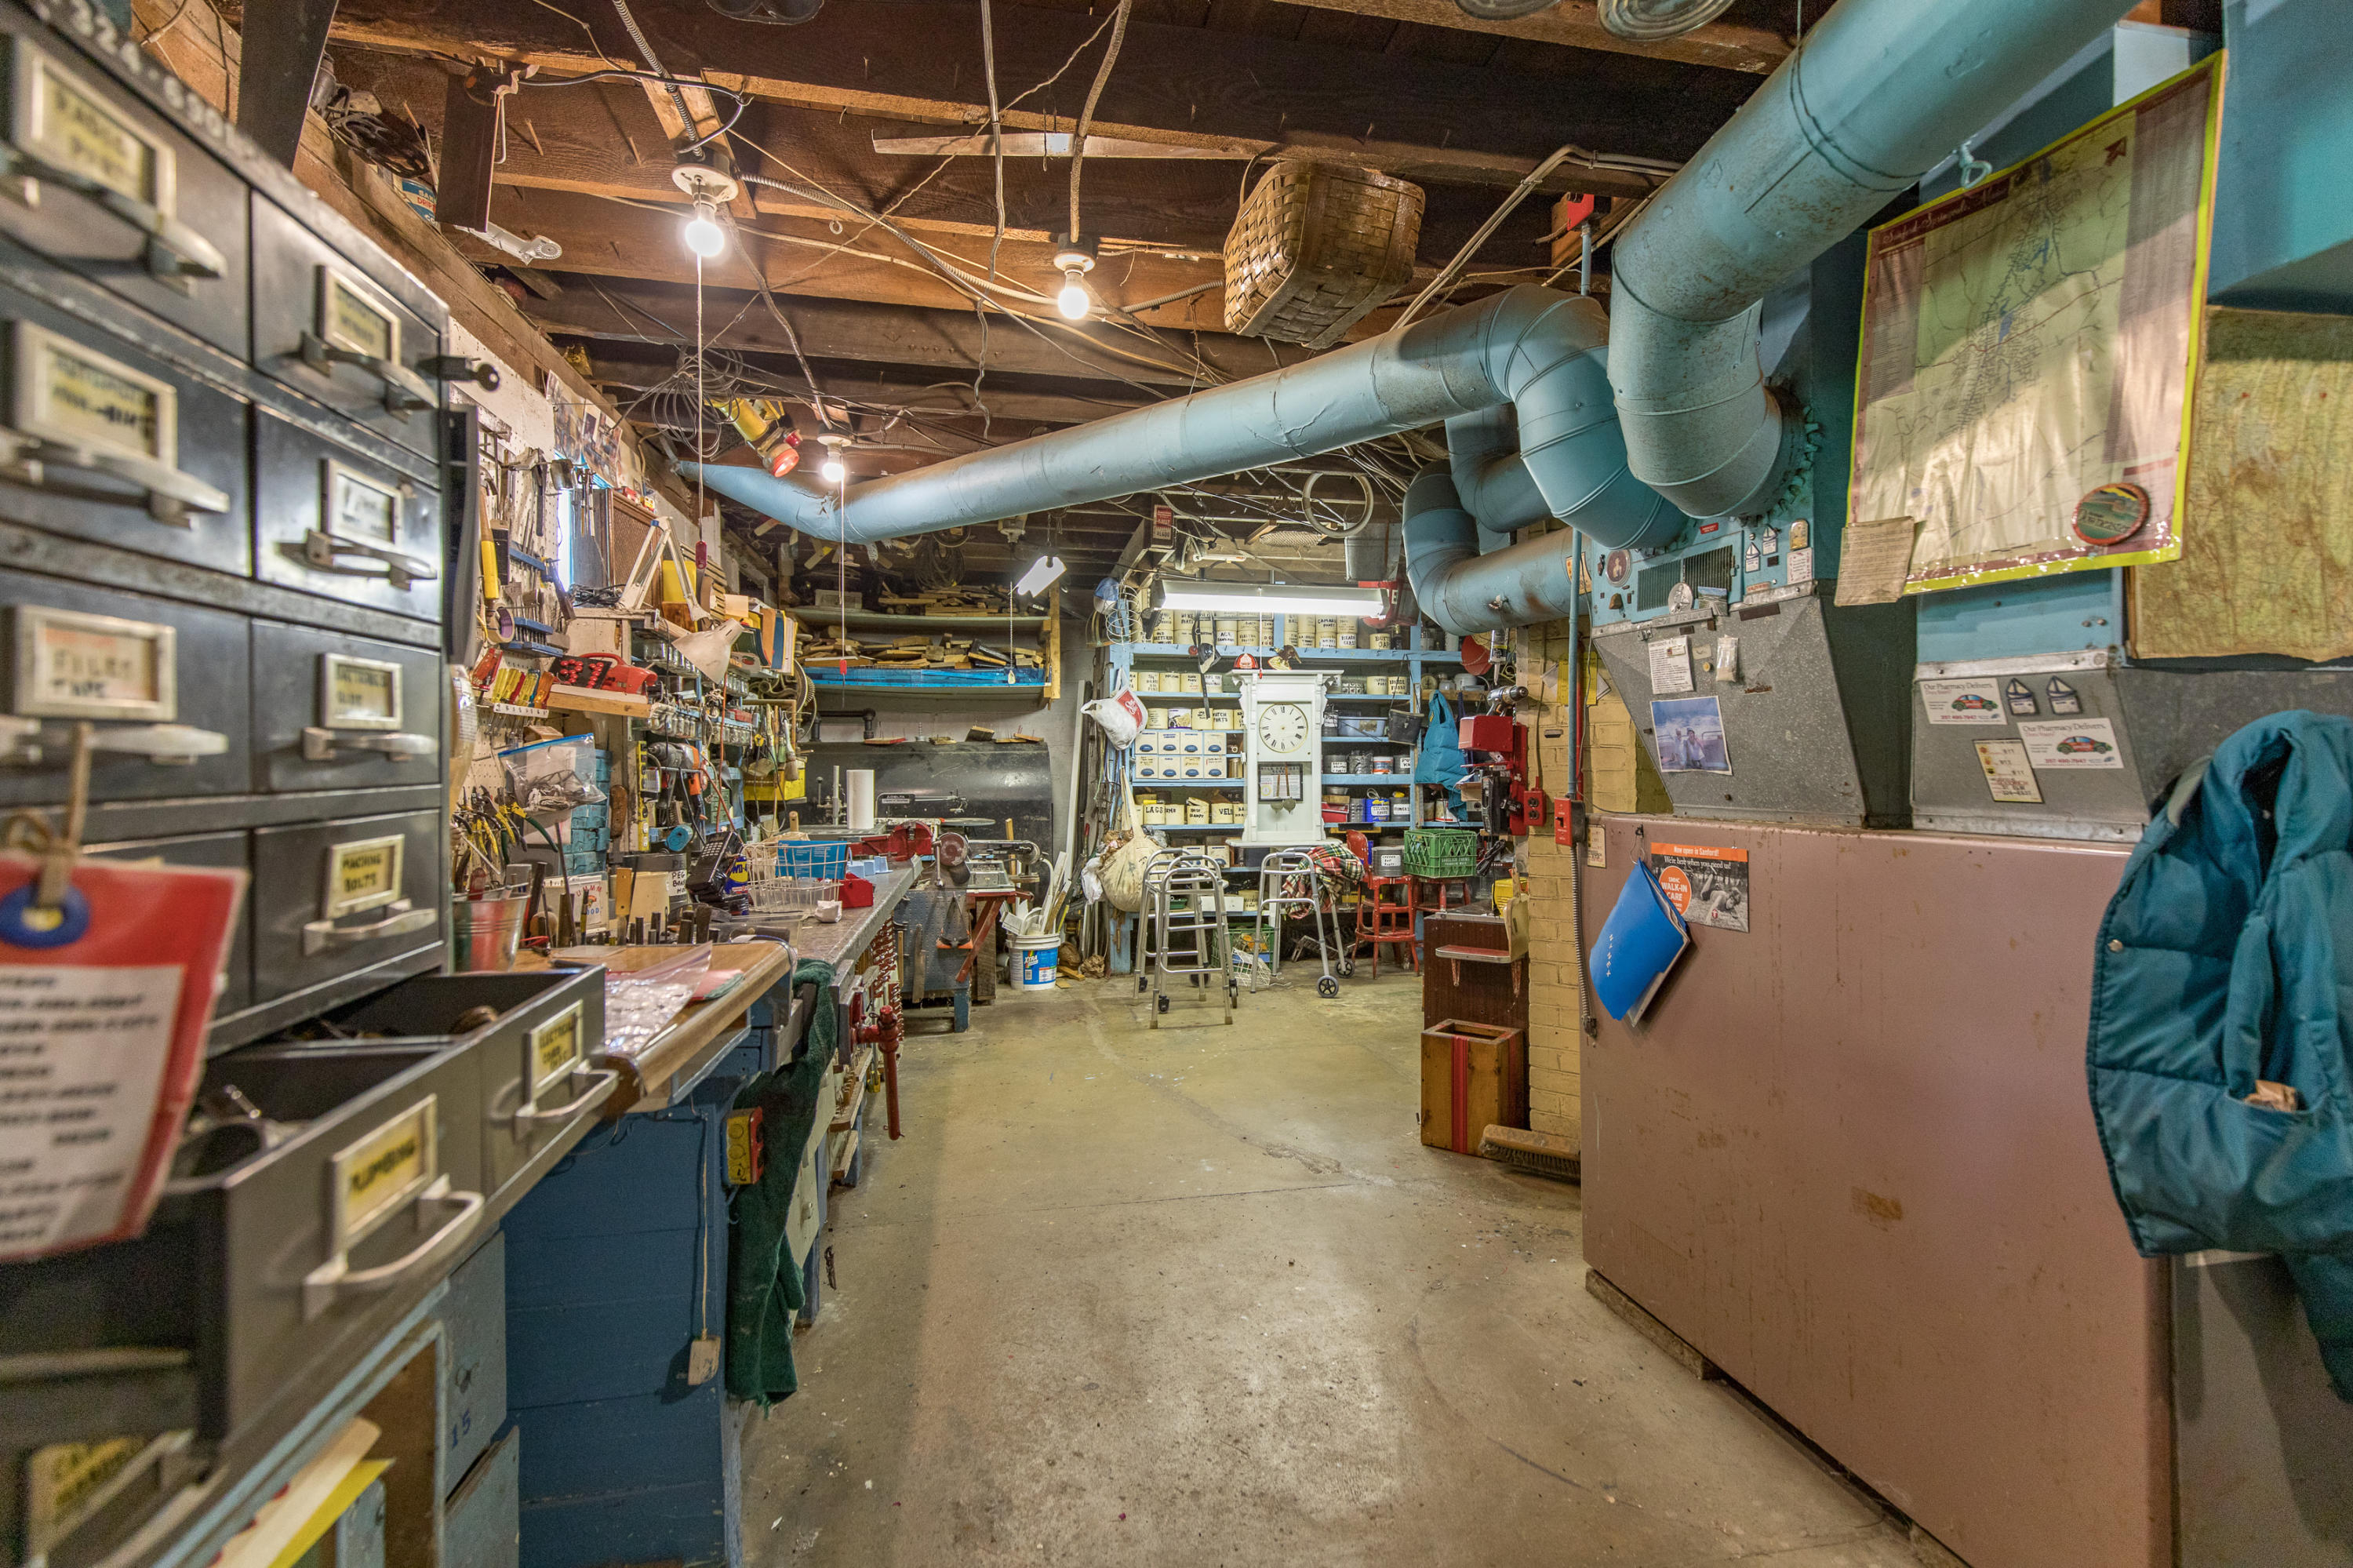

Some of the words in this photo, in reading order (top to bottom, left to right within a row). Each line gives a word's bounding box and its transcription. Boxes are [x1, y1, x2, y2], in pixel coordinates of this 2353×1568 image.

[1699, 847, 1719, 857] Sanford!
[1661, 882, 1688, 893] WALK-IN
[1667, 892, 1682, 901] CARE
